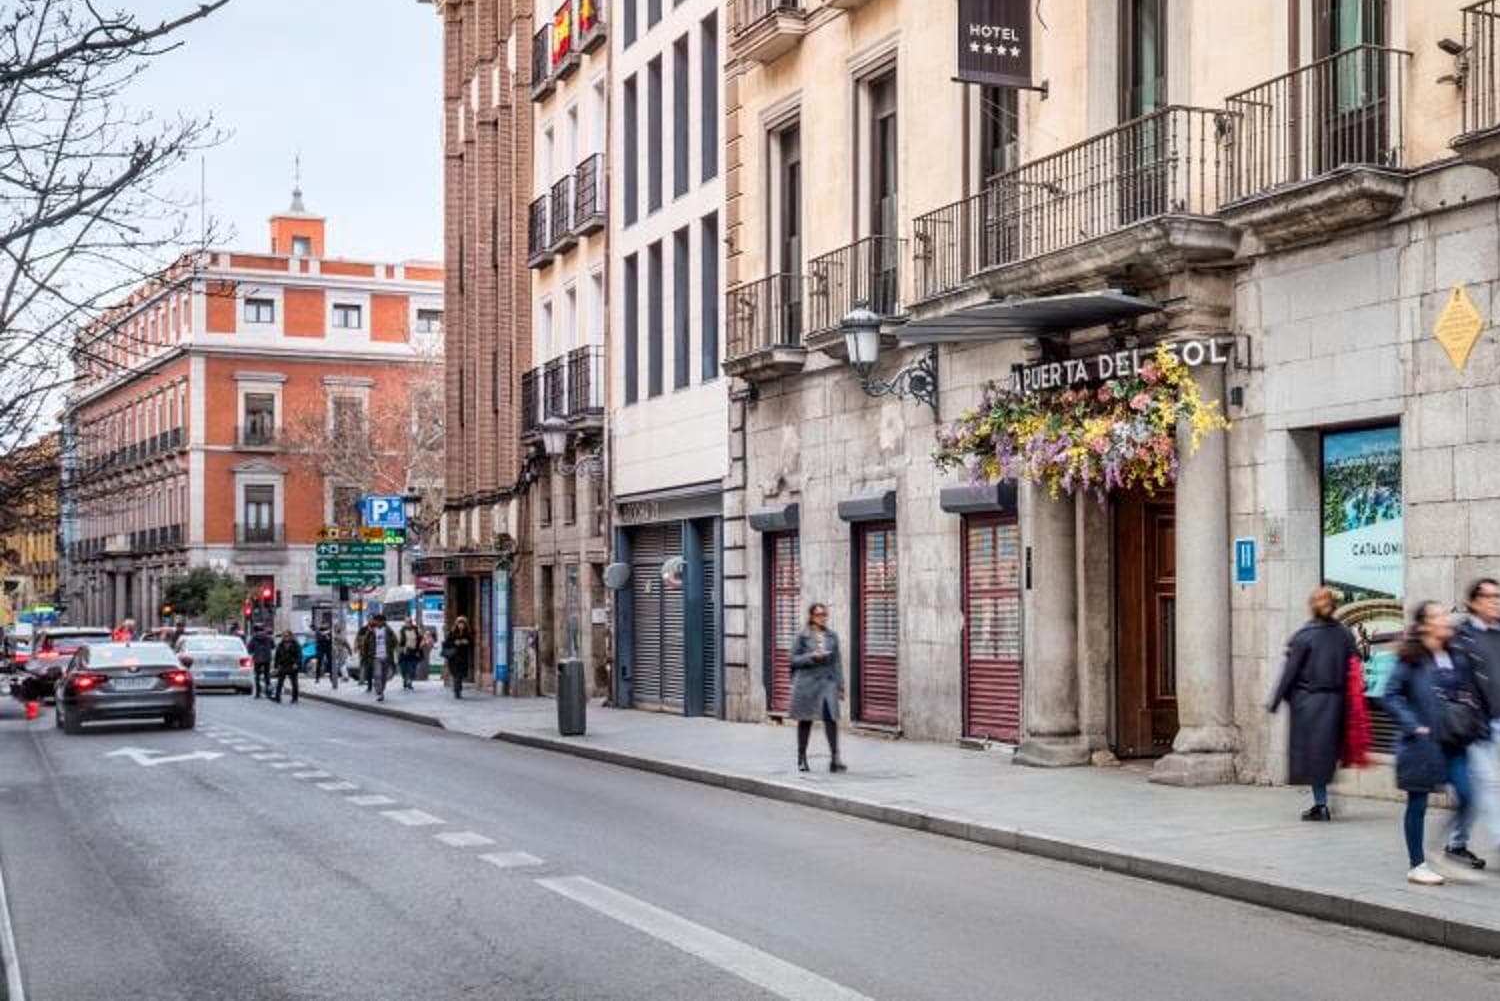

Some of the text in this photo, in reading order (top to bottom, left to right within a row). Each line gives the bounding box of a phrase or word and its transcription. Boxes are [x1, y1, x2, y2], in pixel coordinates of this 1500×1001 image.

[969, 23, 1020, 41] HOTEL
[1023, 359, 1089, 392] PUERTA
[1099, 349, 1143, 378] DEL
[372, 499, 389, 520] P
[1351, 541, 1403, 556] CATALONI
